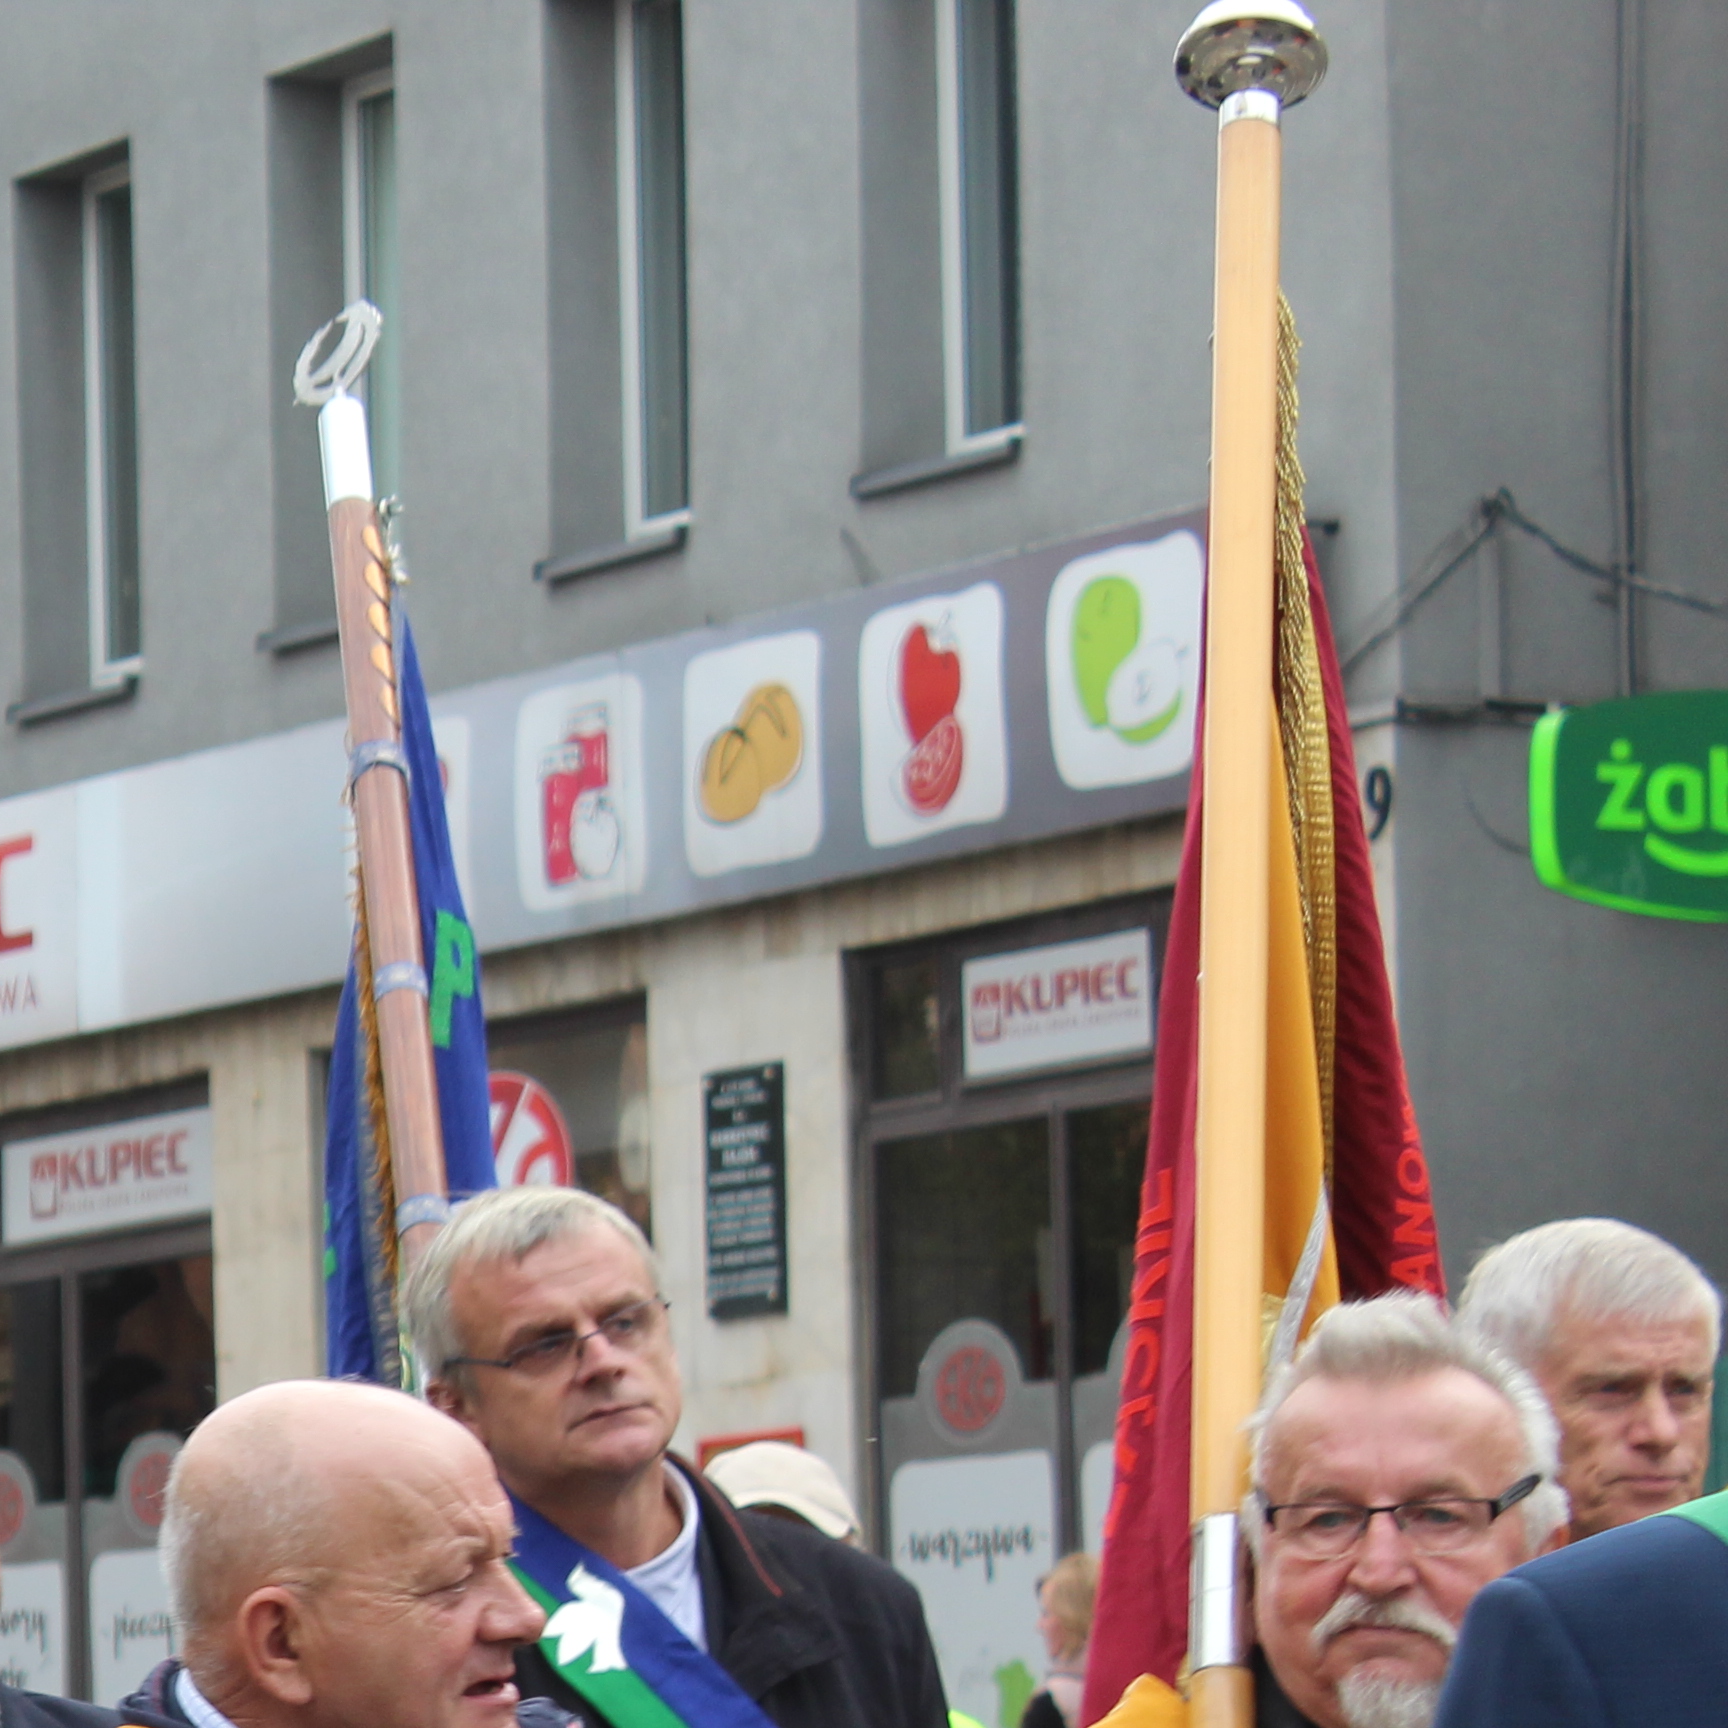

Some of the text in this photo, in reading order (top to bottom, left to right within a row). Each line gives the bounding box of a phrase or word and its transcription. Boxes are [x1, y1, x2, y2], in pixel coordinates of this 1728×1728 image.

[1366, 766, 1392, 840] 9
[1002, 956, 1138, 1018] KUPIEC
[59, 1130, 187, 1193] KUPIEC
